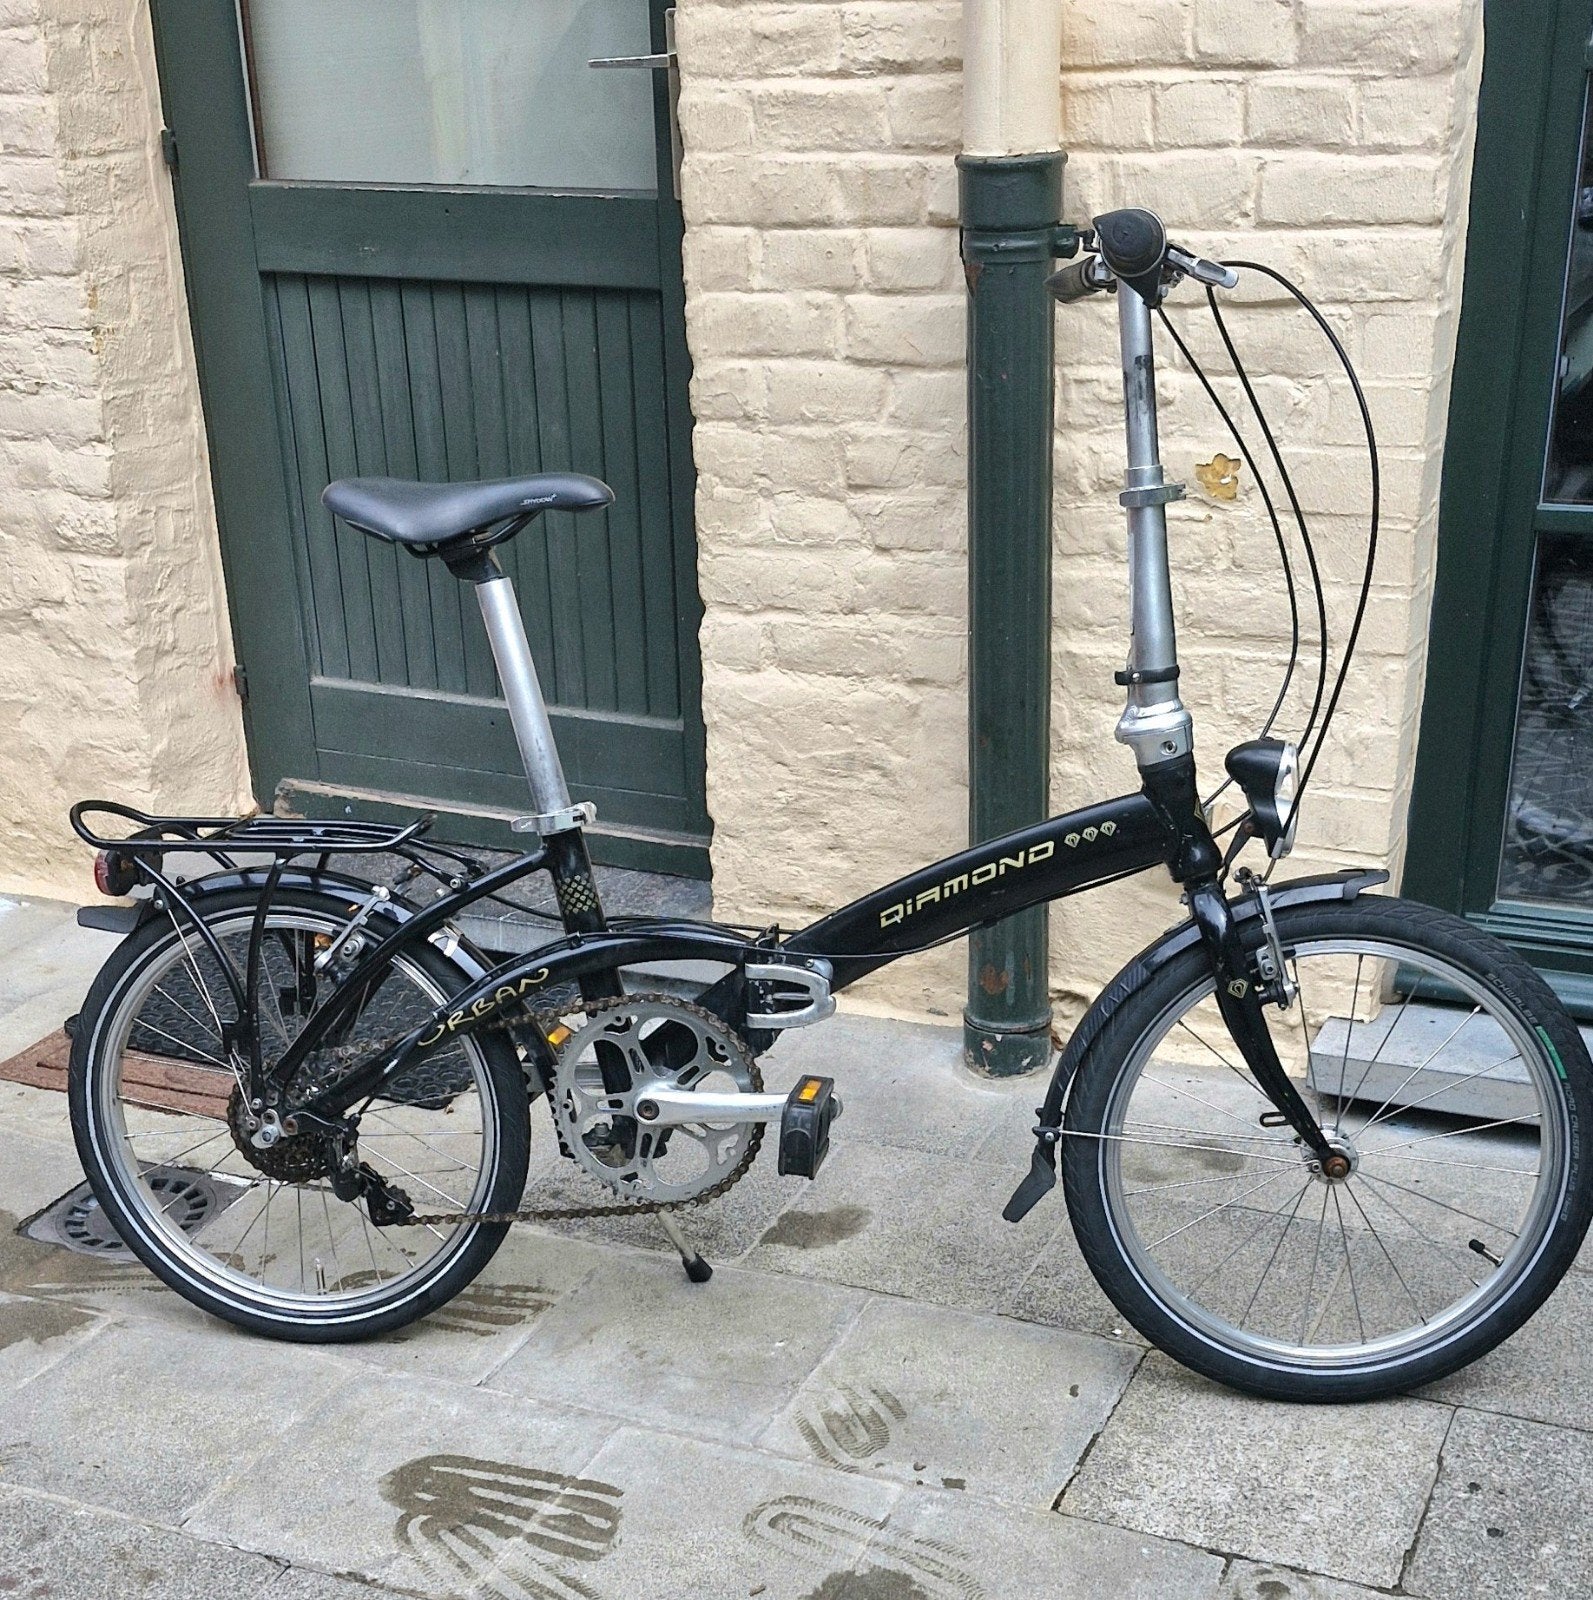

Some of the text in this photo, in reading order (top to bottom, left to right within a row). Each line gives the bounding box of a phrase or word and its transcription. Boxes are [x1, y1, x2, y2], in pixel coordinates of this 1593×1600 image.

[417, 967, 549, 1046] URBAN
[1484, 973, 1539, 1025] SCHWALBE
[1562, 1082, 1577, 1111] ROAD
[1571, 1114, 1580, 1160] CRUISER
